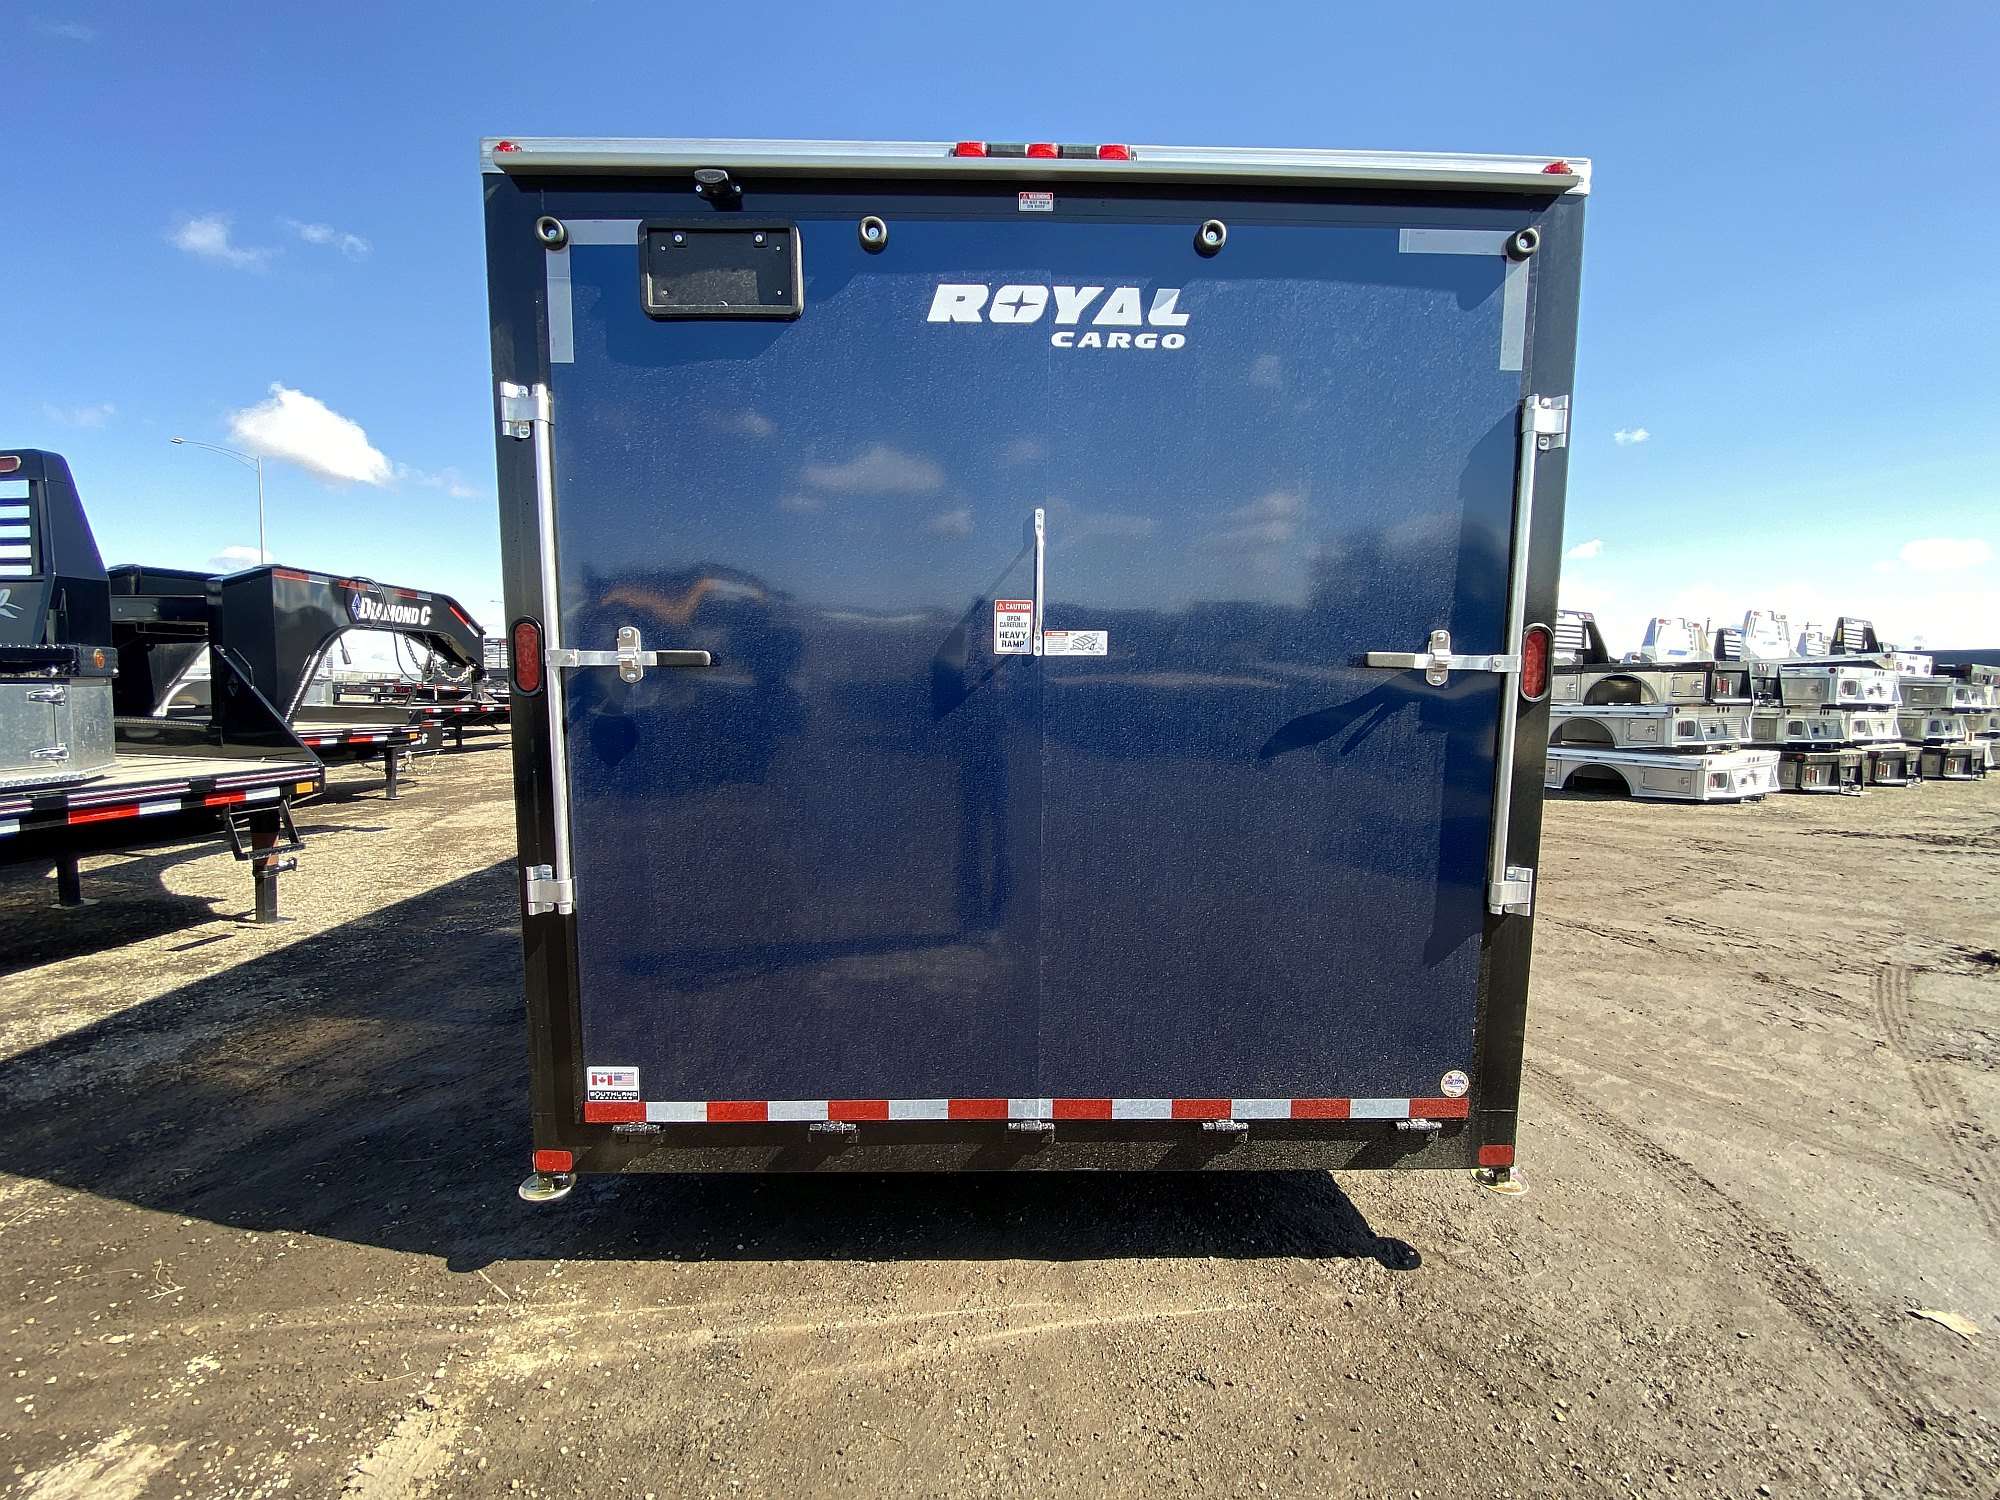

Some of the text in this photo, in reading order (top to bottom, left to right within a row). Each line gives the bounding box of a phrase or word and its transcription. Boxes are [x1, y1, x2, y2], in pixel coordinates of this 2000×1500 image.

[927, 284, 1190, 326] ROYAL
[1051, 332, 1186, 349] CARGO
[359, 597, 431, 625] DIAMOND C
[999, 631, 1027, 639] HEAVY
[1001, 640, 1025, 648] RAMP
